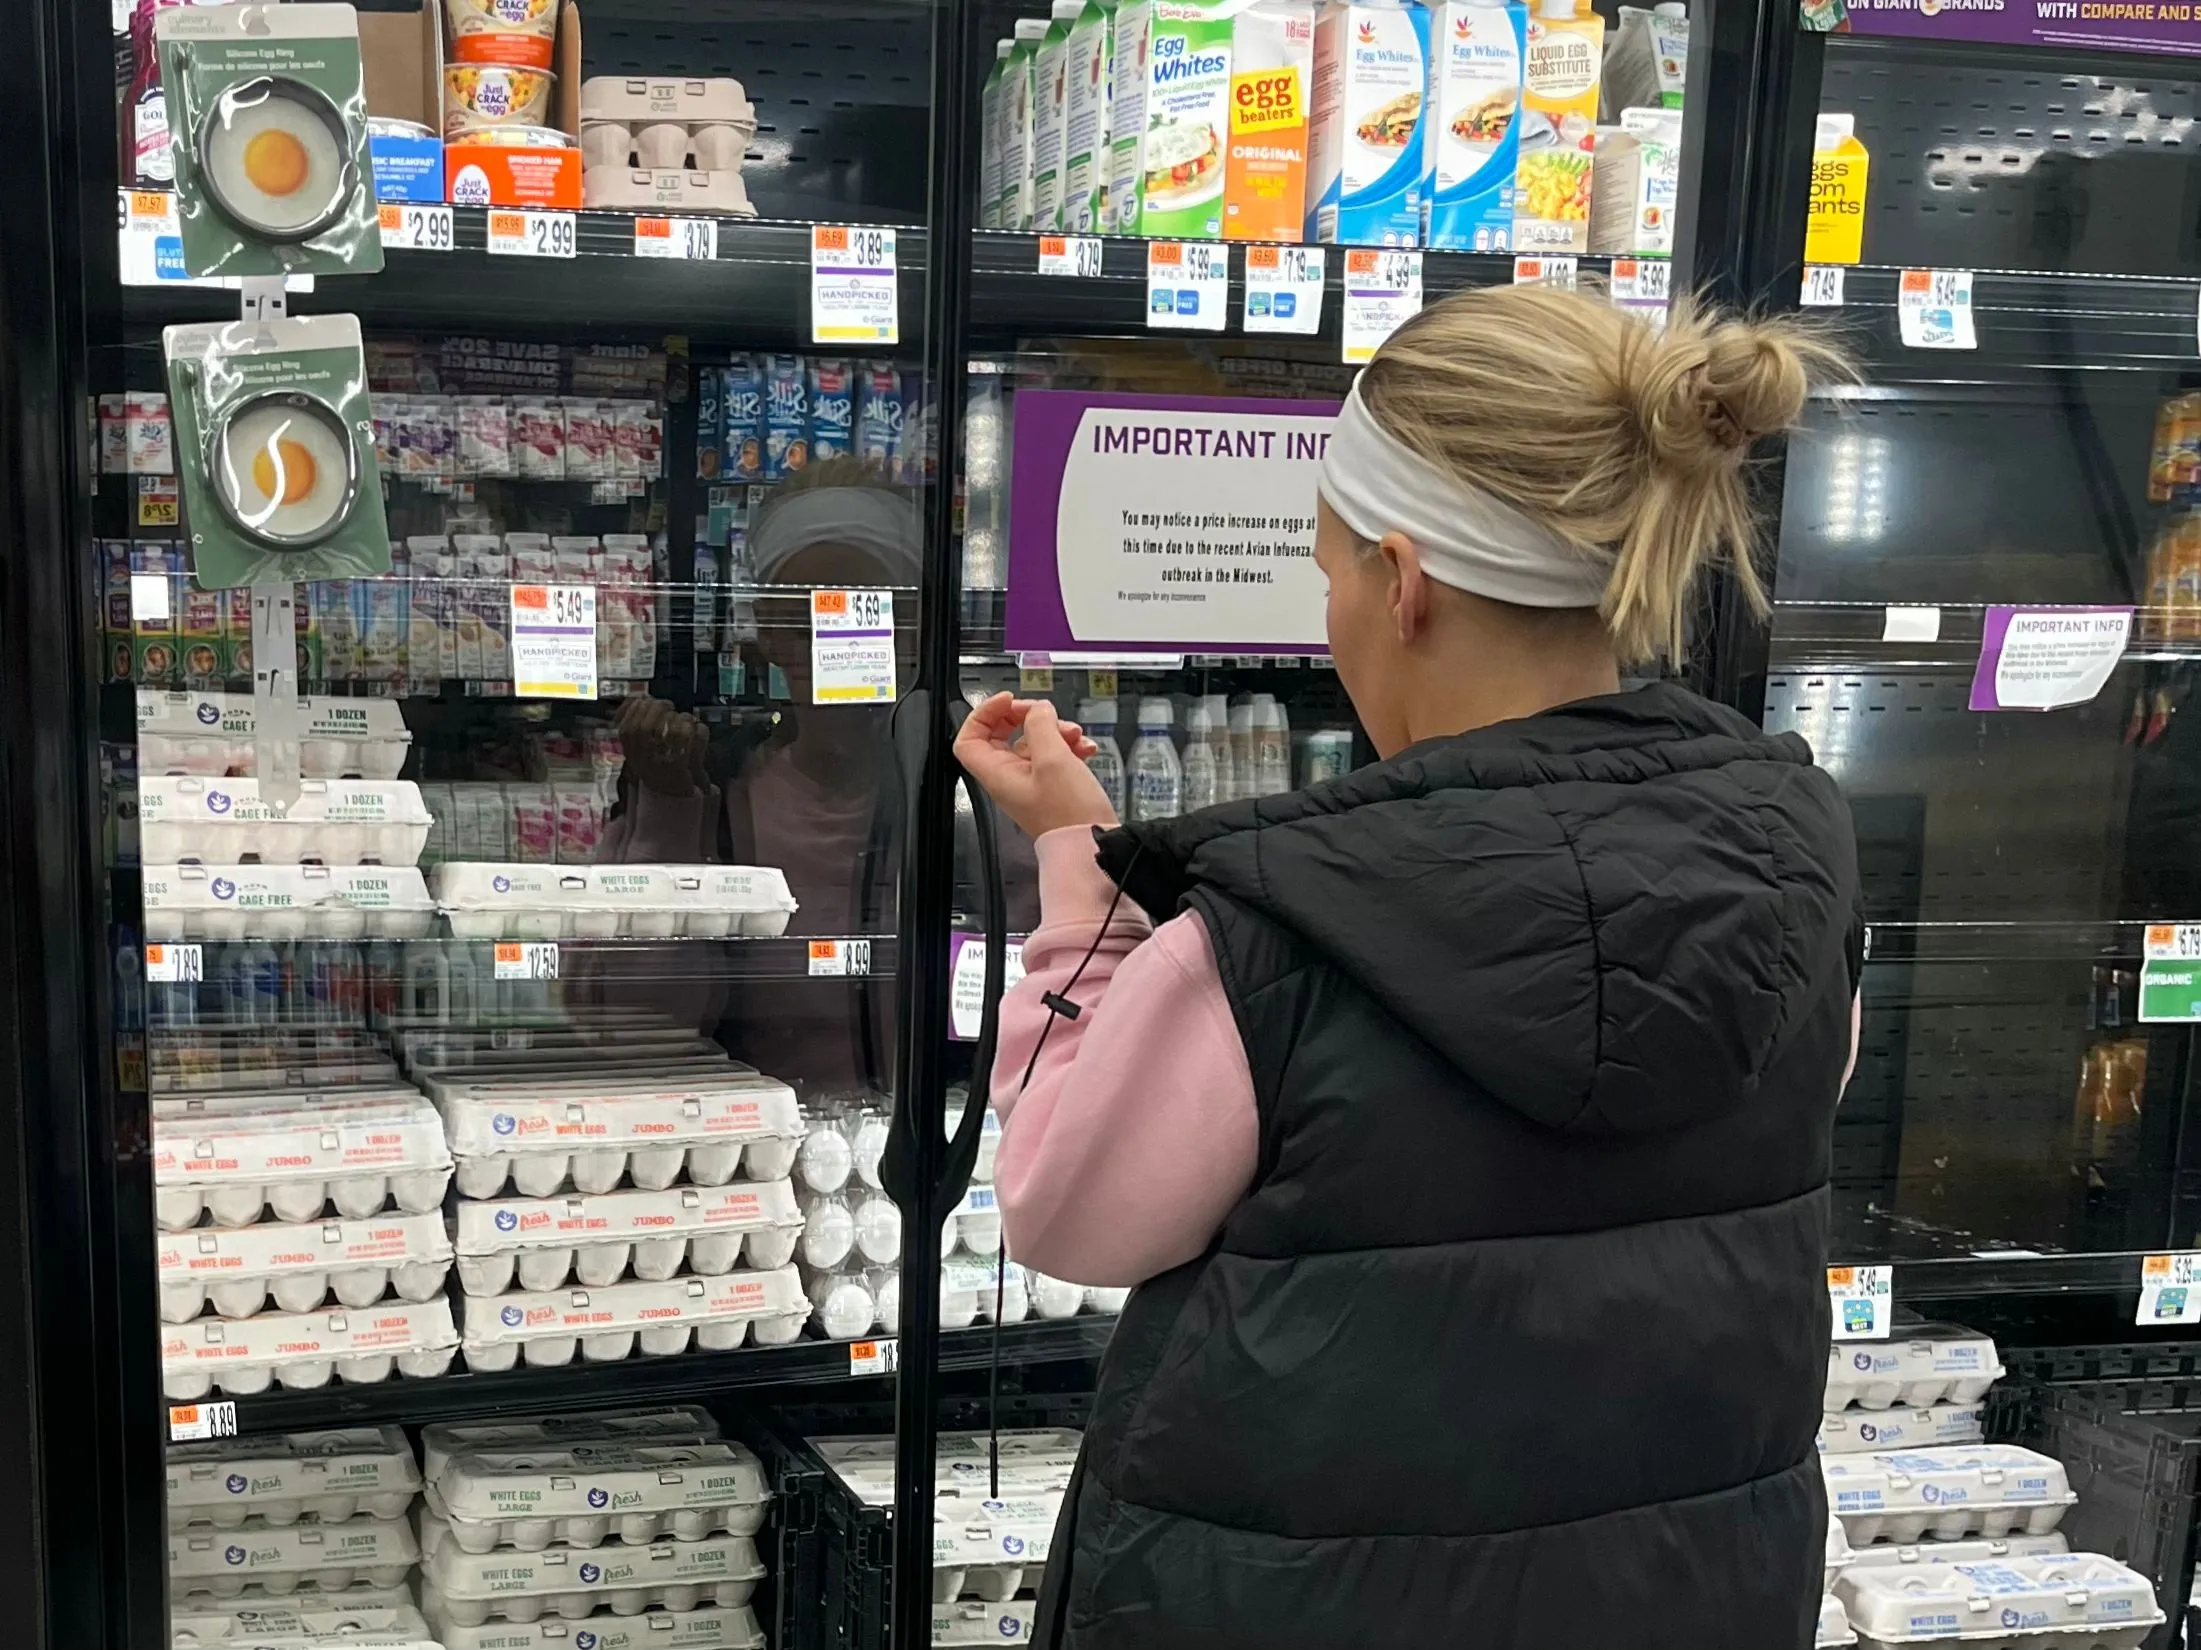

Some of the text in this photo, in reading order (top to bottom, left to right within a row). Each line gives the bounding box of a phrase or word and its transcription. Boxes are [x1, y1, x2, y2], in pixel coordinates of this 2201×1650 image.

[2037, 2, 2189, 20] WITH COMPARE AND
[1154, 37, 1184, 57] Egg
[1452, 45, 1510, 58] Egg Whites
[1530, 44, 1587, 64] LIQUID EGG
[1356, 49, 1413, 63] Egg Whites
[1154, 54, 1225, 84] Whites
[1528, 59, 1591, 77] SUBSTITUTE
[477, 94, 510, 104] CRACK
[1236, 76, 1292, 109] egg
[1240, 107, 1294, 124] beaters
[1232, 146, 1302, 162] ORIGINAL
[455, 187, 488, 197] CRACK
[408, 212, 450, 247] $2.99
[532, 218, 573, 254] $2.99
[822, 291, 888, 300] HANDPICKED
[1093, 424, 1276, 460] IMPORTANT
[1122, 510, 1315, 533] You may notice a price increase on eggs at
[1123, 538, 1140, 554] this
[1143, 539, 1163, 554] time
[1166, 539, 1182, 555] due
[1185, 541, 1194, 555] to
[1197, 540, 1211, 556] the
[1214, 541, 1244, 556] recent
[1246, 541, 1270, 556] Avian
[1161, 566, 1273, 584] outbreak in the Midwest.
[554, 590, 582, 624] $5.49
[852, 594, 879, 627] $5.69
[2016, 619, 2123, 633] IMPORTANT INFO
[522, 648, 587, 658] HANDPICKED
[822, 651, 887, 661] HANDPICKED
[328, 708, 366, 720] 1 DOZEN
[222, 719, 247, 732] CAGE
[344, 794, 383, 806] 1 DOZEN
[234, 808, 260, 820] CAGE
[357, 879, 388, 891] DOZEN
[600, 875, 649, 886] WHITE EGGS
[605, 886, 644, 894] LARGE
[238, 894, 293, 905] CAGE FREE
[2146, 973, 2192, 986] ORGANIC
[518, 1116, 549, 1135] fresh
[632, 1124, 674, 1134] JUMBO
[184, 1155, 312, 1171] WHITE EGGS JUMBO
[519, 1211, 551, 1231] fresh
[558, 1218, 584, 1230] WHITE
[632, 1215, 675, 1226] JUMBO
[189, 1252, 315, 1269] WHITE EGGS JUMBO
[525, 1306, 557, 1324] fresh
[563, 1312, 590, 1323] WHITE
[638, 1307, 681, 1318] JUMBO
[195, 1341, 320, 1358] WHITE EGGS JUMBO
[206, 1405, 235, 1437] $8.89
[349, 1463, 378, 1474] DOZEN
[251, 1477, 282, 1494] fresh
[707, 1476, 736, 1488] DOZEN
[490, 1490, 542, 1502] WHITE EGGS
[612, 1491, 643, 1510] fresh
[498, 1502, 533, 1513] LARGE
[348, 1535, 377, 1546] DOZEN
[250, 1547, 281, 1566] fresh
[698, 1551, 726, 1562] DOZEN
[482, 1568, 534, 1581] WHITE EGGS
[604, 1565, 634, 1584] fresh
[491, 1580, 526, 1591] LARGE
[694, 1619, 722, 1630] DOZEN
[479, 1637, 531, 1649] WHITE EGGS
[600, 1632, 631, 1650] fresh
